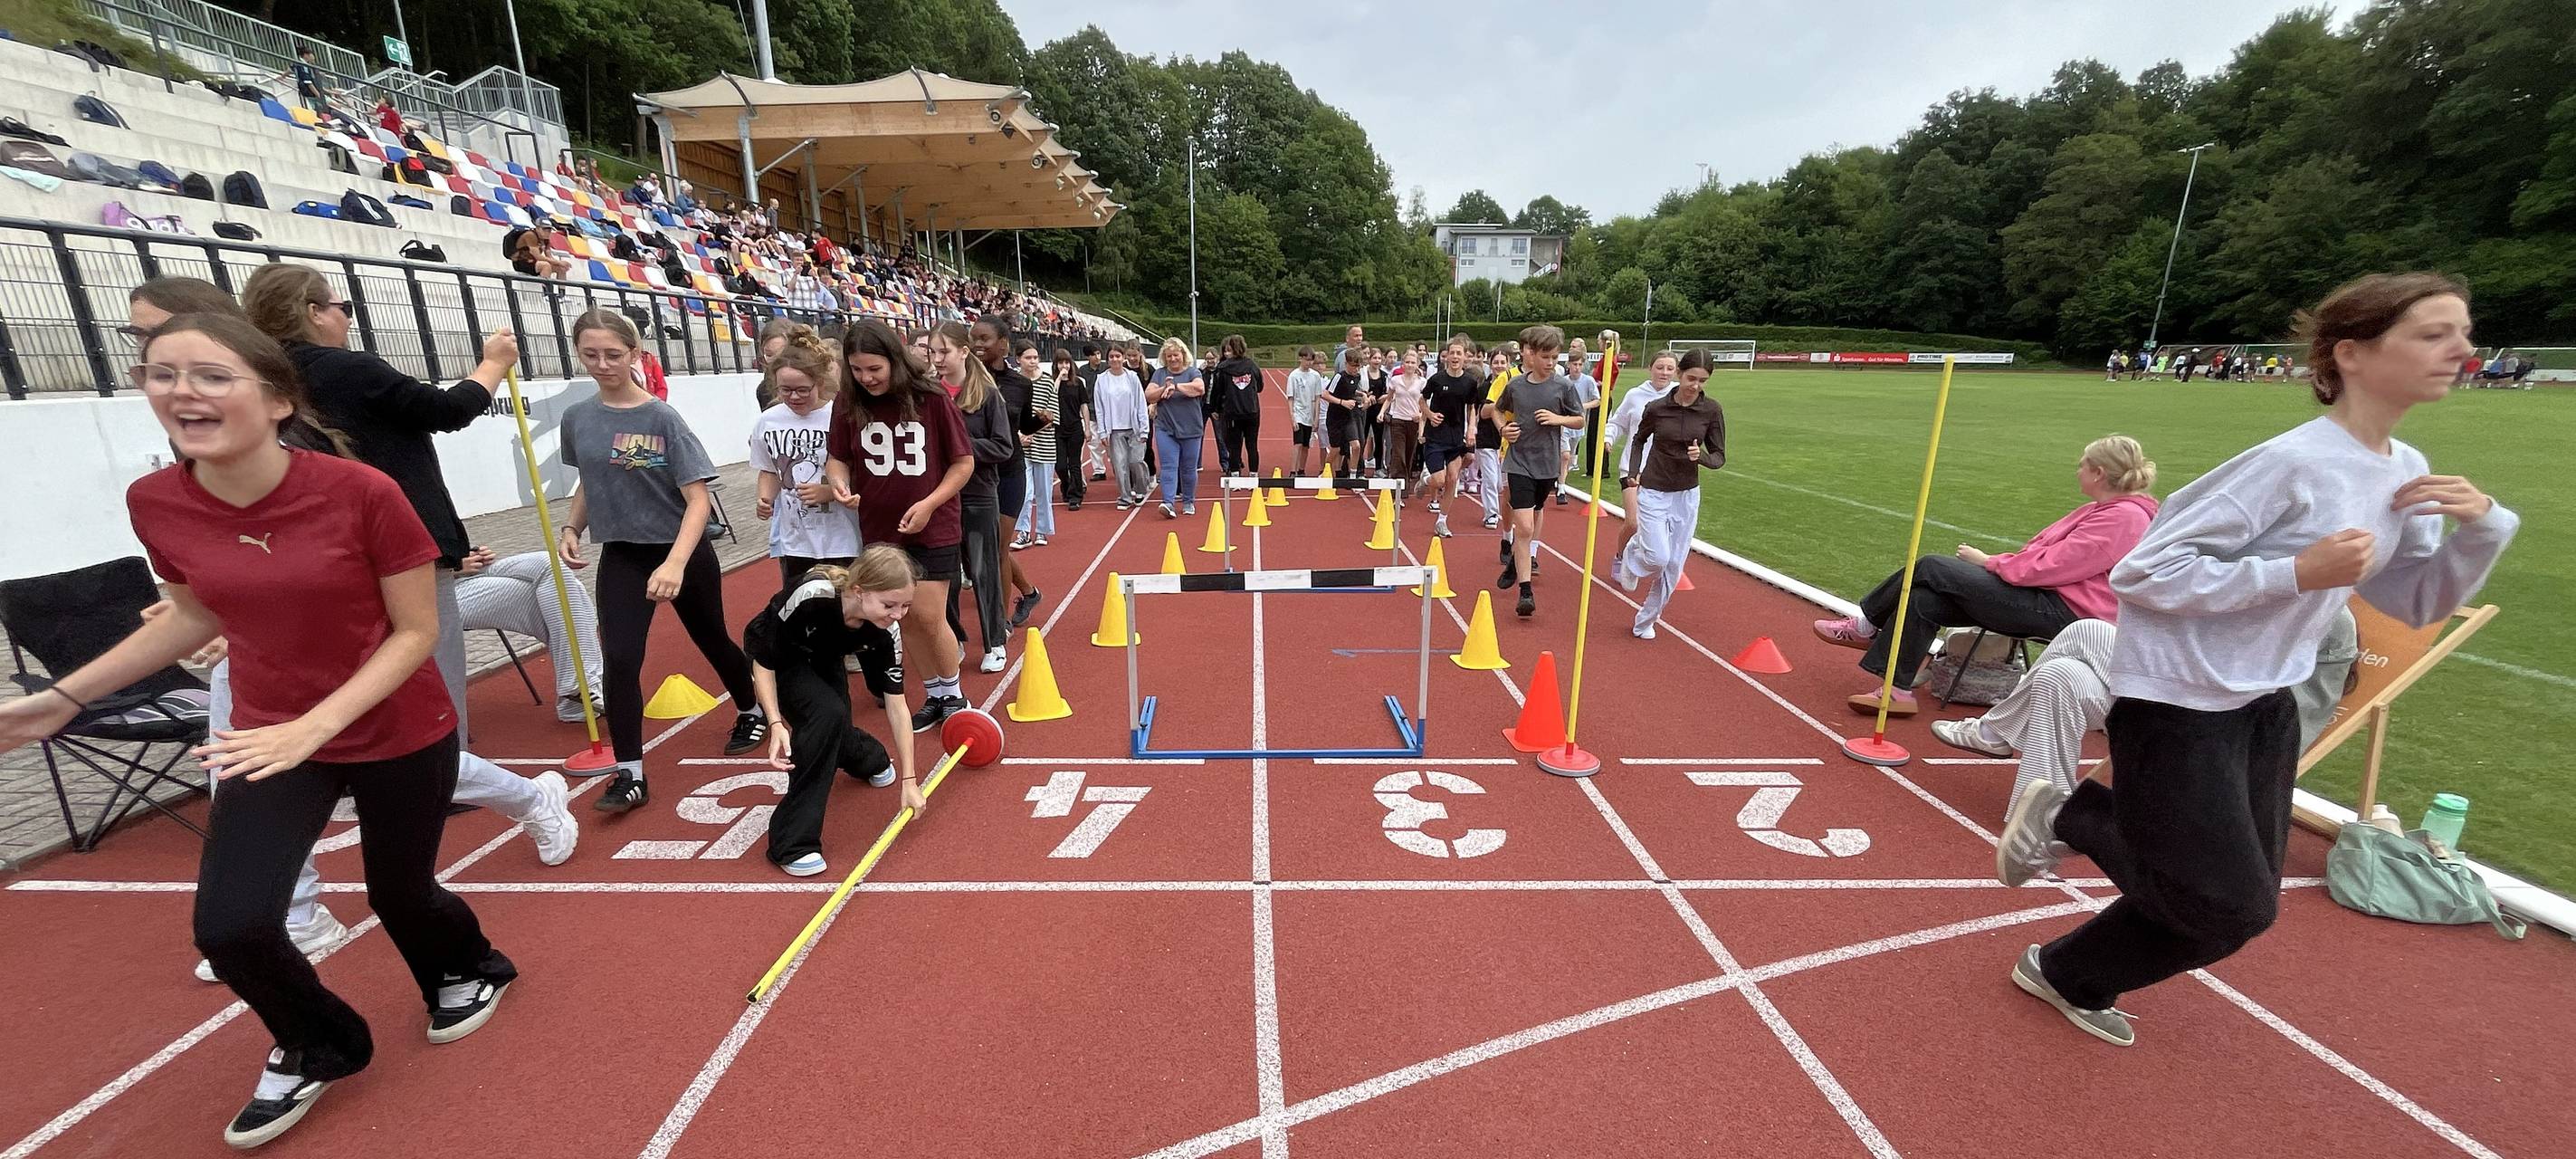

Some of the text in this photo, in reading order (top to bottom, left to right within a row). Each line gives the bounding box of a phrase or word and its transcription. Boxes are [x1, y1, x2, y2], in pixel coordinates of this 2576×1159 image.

[860, 421, 927, 476] 93
[611, 771, 790, 859] 5
[1024, 771, 1153, 858] 4
[1372, 771, 1507, 858] 3
[1684, 771, 1871, 858] 2
